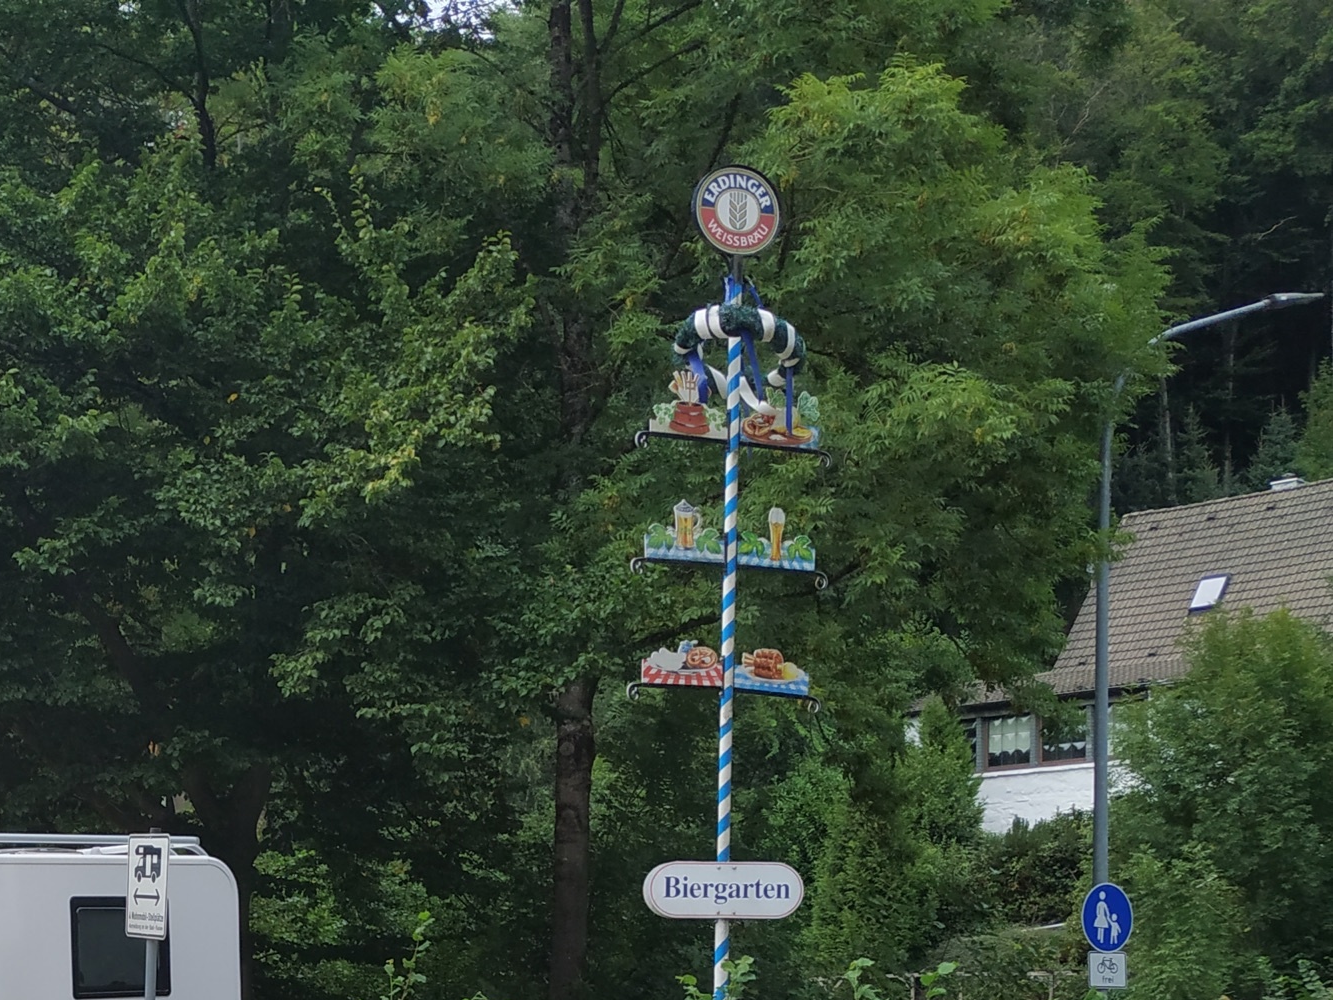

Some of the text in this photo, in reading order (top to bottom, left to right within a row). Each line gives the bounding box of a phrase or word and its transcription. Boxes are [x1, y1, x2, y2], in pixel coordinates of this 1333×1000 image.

[703, 174, 771, 209] ERDINGER
[664, 876, 790, 905] Biergarten
[1102, 975, 1115, 984] frei
